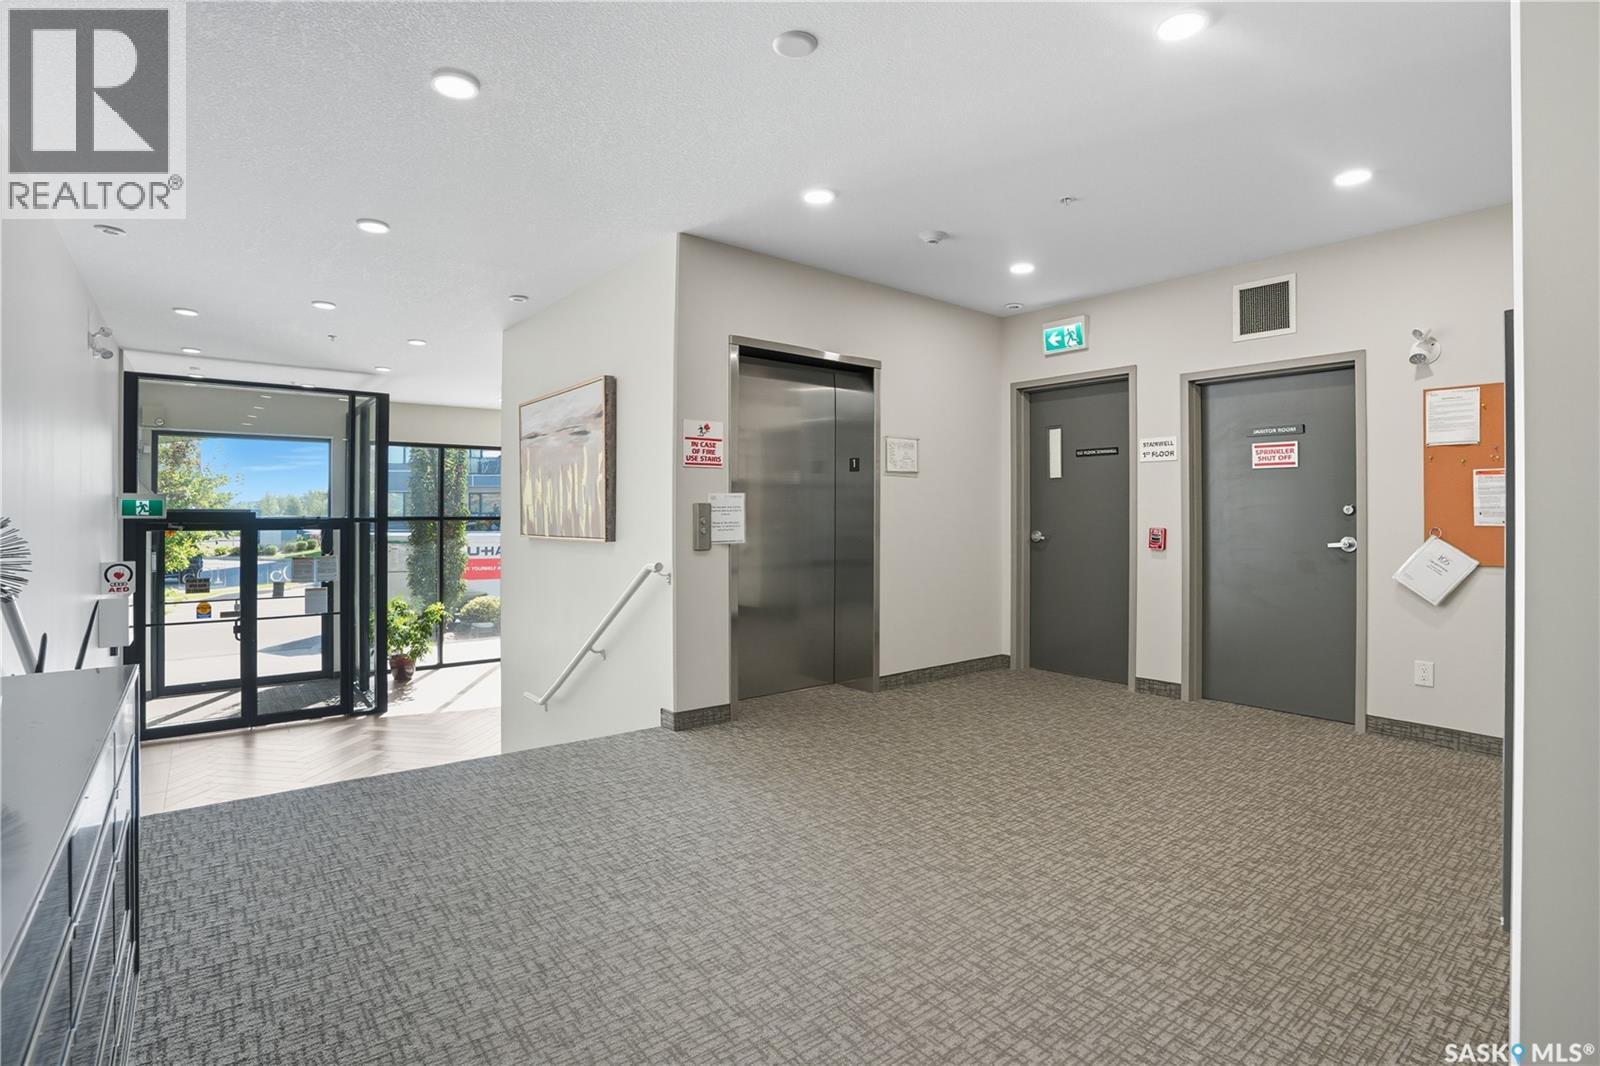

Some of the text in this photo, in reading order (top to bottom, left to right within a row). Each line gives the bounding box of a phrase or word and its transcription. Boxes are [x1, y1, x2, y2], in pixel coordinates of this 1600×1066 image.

[700, 441, 716, 449] CASE
[1142, 440, 1175, 448] STAIRWELL
[1151, 450, 1175, 458] FLOOR
[1255, 447, 1295, 456] SPRINKLER
[700, 455, 722, 463] STAIRS
[1257, 454, 1276, 462] SHUT
